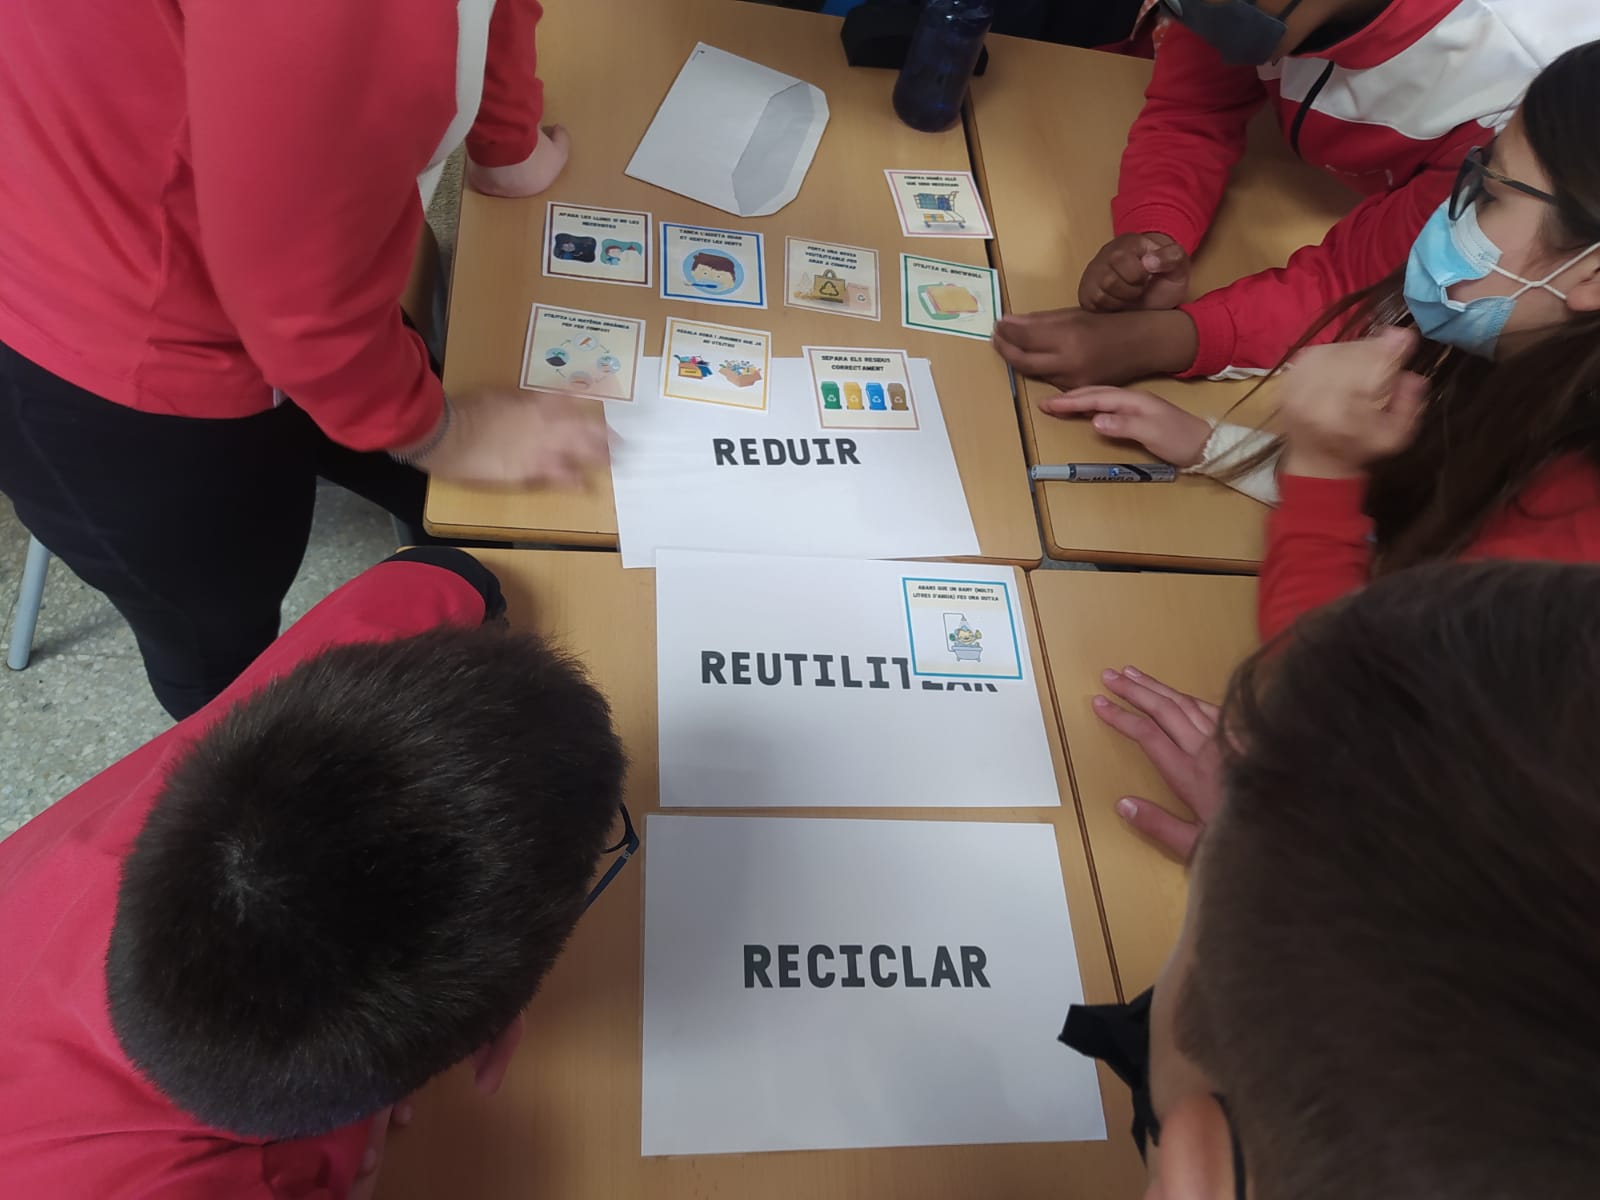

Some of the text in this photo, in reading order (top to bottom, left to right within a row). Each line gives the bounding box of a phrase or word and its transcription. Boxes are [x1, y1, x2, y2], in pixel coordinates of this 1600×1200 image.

[712, 438, 861, 466] REDUIR
[701, 650, 998, 692] REUTILIT
[743, 944, 992, 989] RECICLAR
